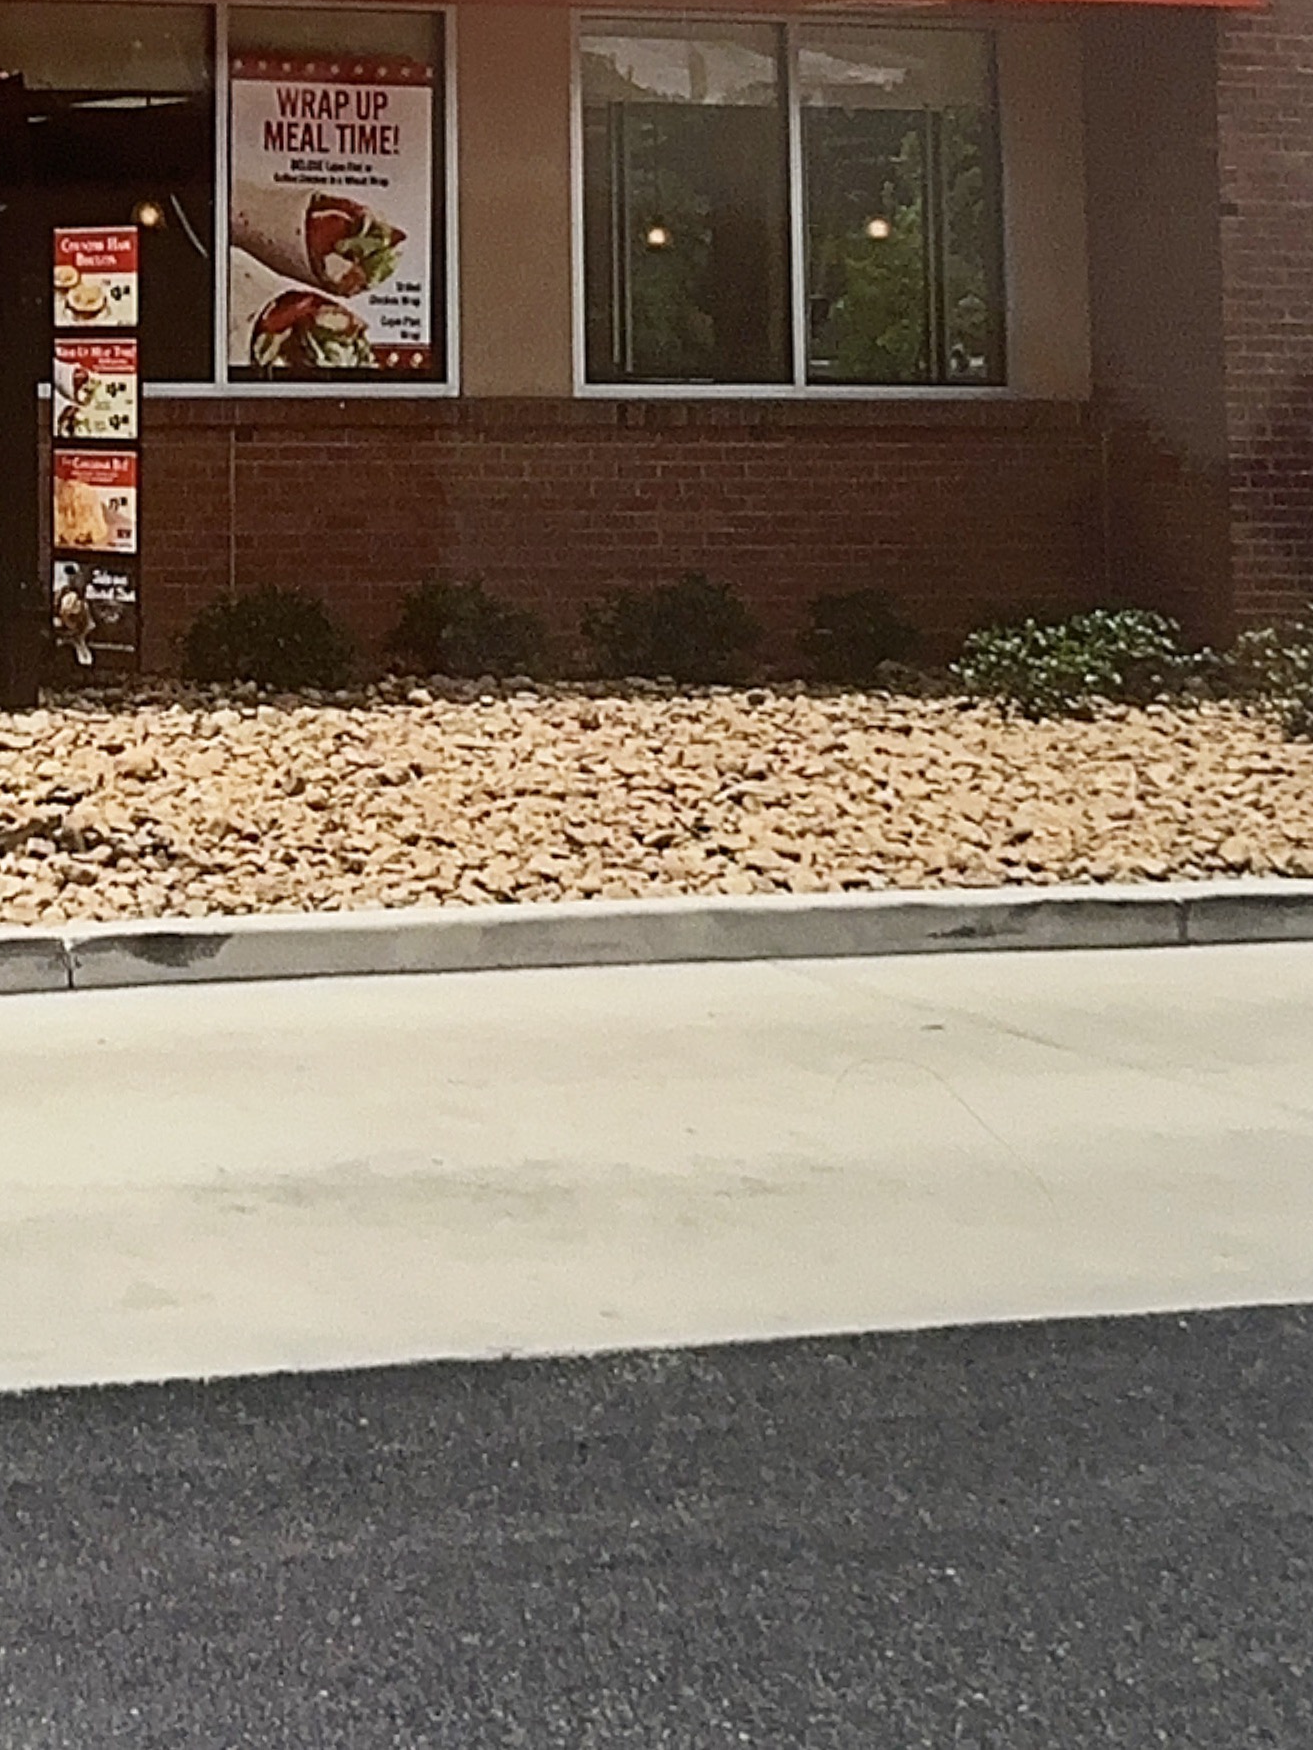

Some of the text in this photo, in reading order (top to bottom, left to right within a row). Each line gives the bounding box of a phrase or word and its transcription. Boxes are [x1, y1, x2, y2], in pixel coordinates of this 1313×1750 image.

[276, 87, 388, 120] WRAP UP
[264, 120, 399, 155] MEAL TIME!
